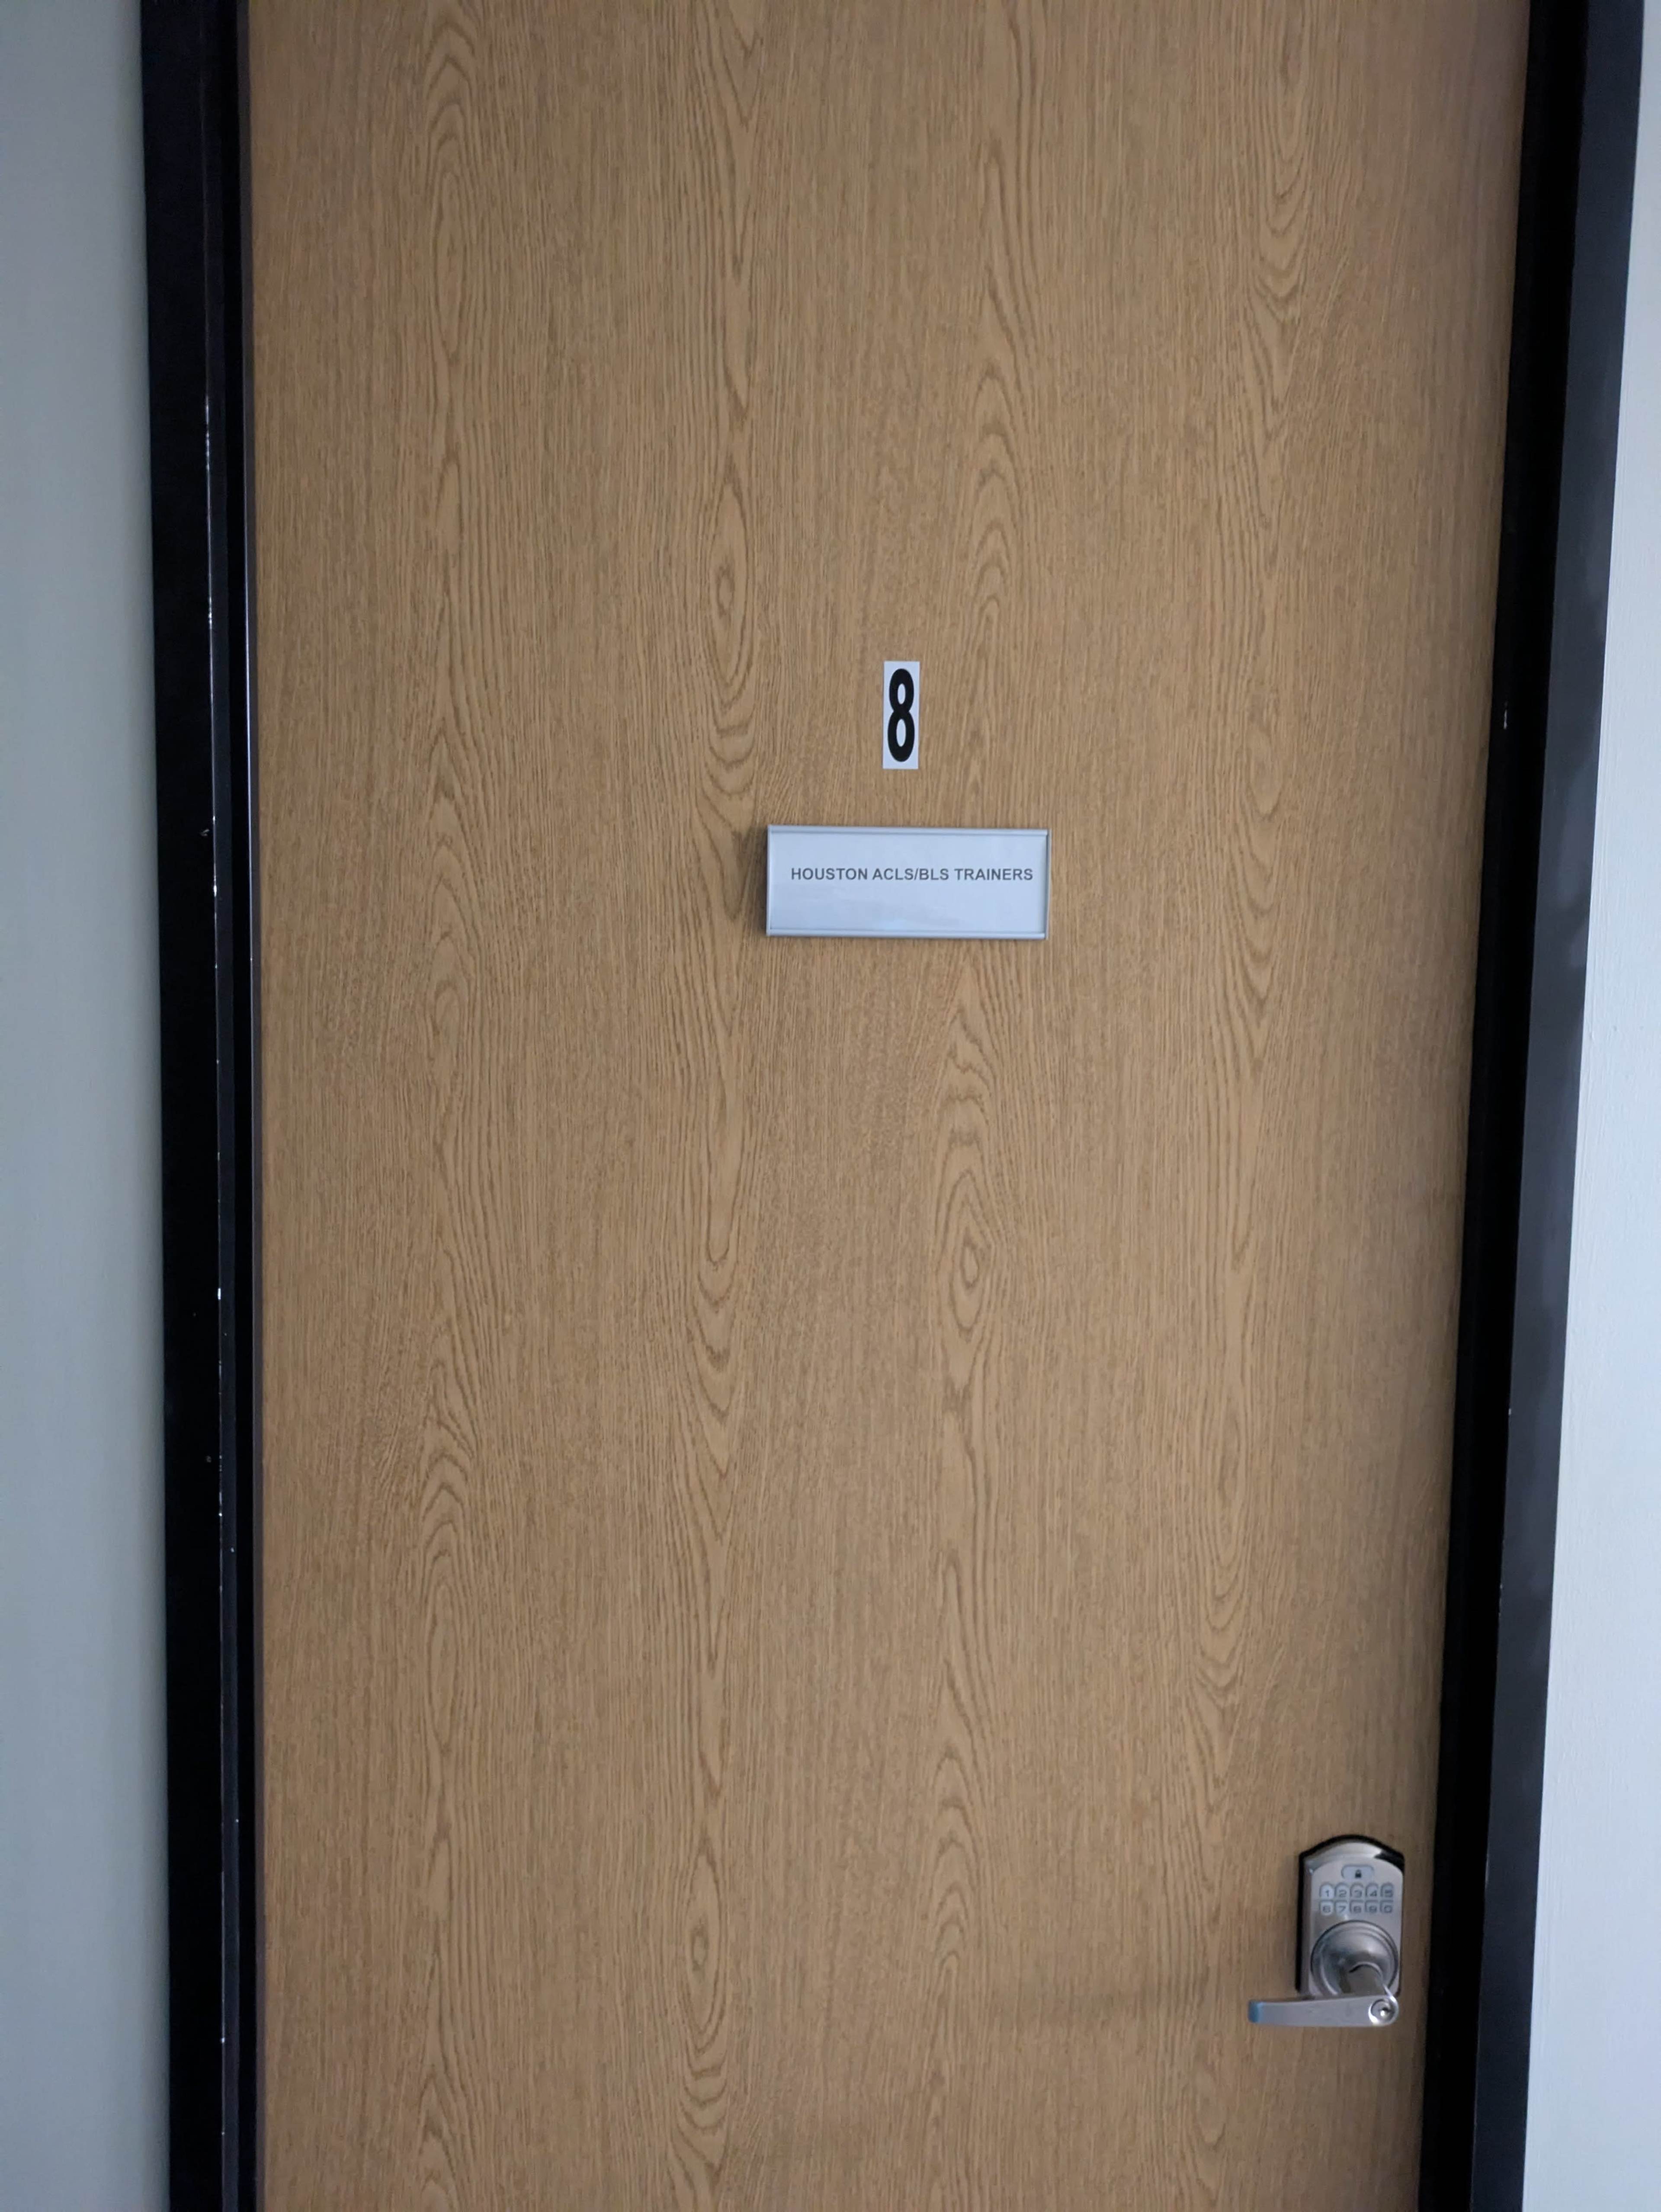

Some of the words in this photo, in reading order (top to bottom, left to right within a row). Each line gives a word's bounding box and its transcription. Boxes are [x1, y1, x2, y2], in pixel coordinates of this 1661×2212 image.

[887, 668, 915, 762] 8
[791, 868, 868, 880] HOUSTON
[872, 868, 949, 881] ACLS/BLS
[954, 868, 1033, 881] TRAINERS
